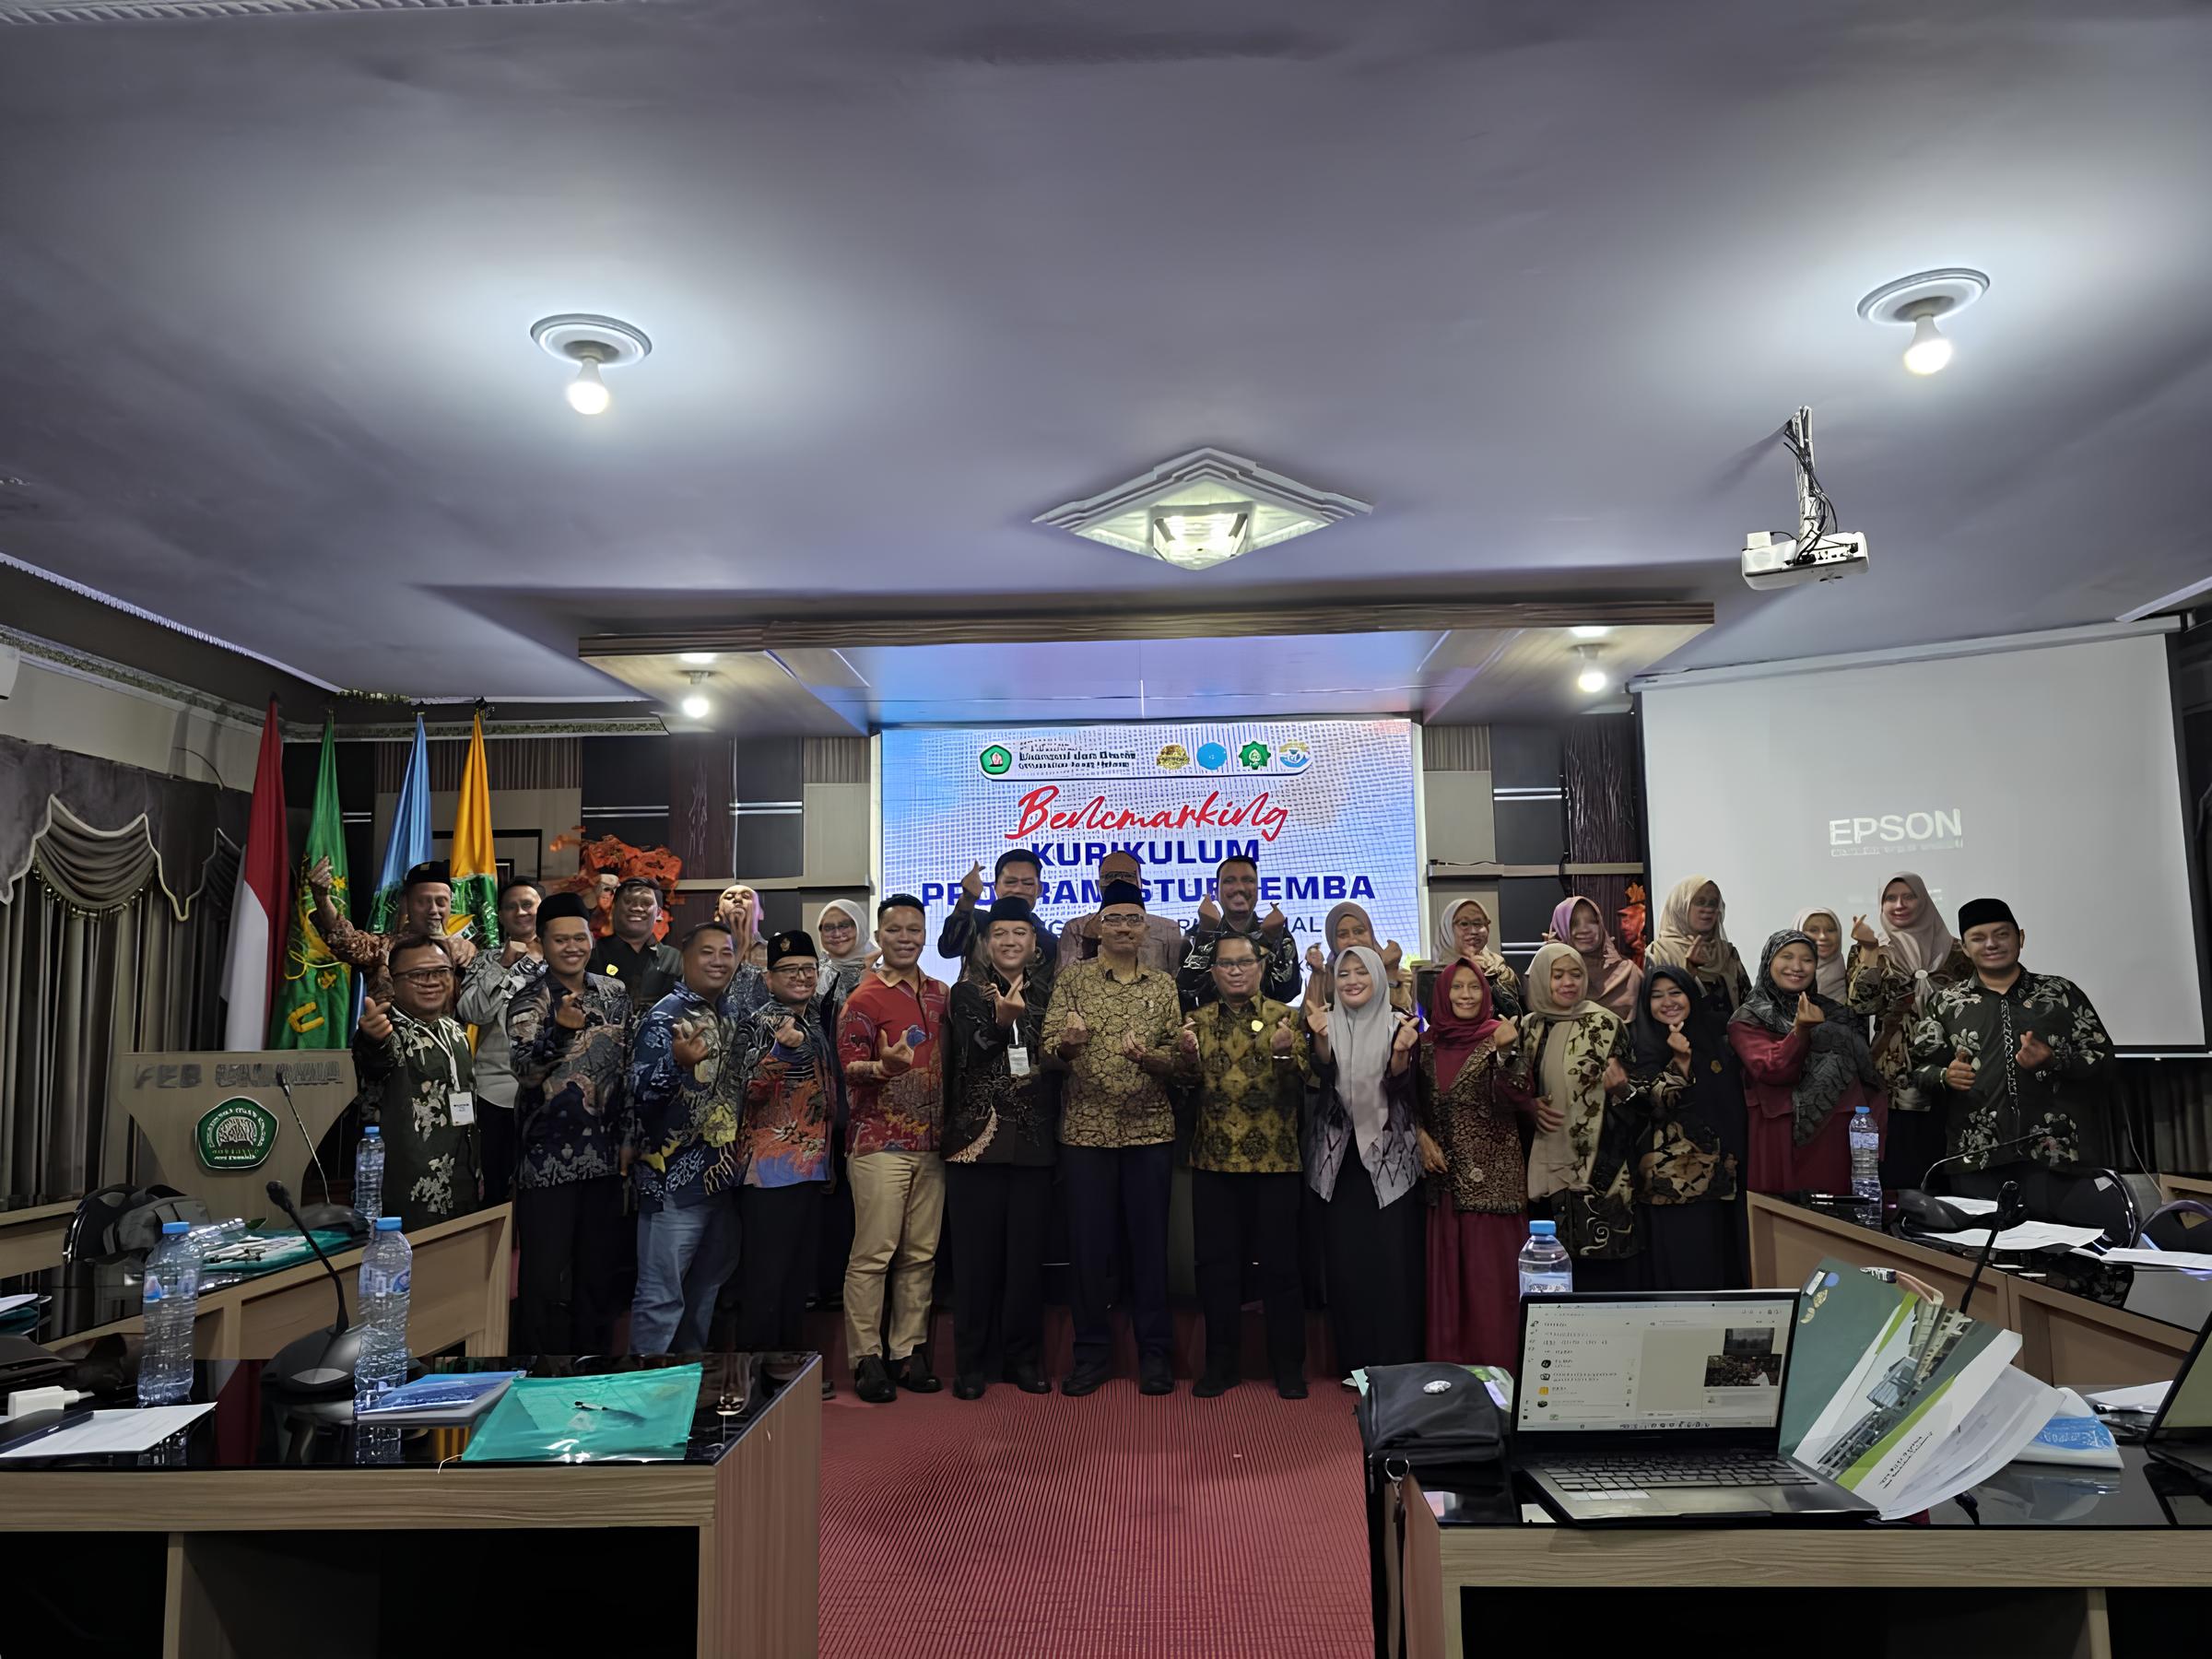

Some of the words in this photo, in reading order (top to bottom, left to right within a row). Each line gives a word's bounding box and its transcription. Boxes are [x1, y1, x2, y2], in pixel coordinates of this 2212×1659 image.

[1830, 808, 1962, 845] EPSON
[922, 879, 1102, 906] PRORAM
[1259, 876, 1375, 900] EMBA
